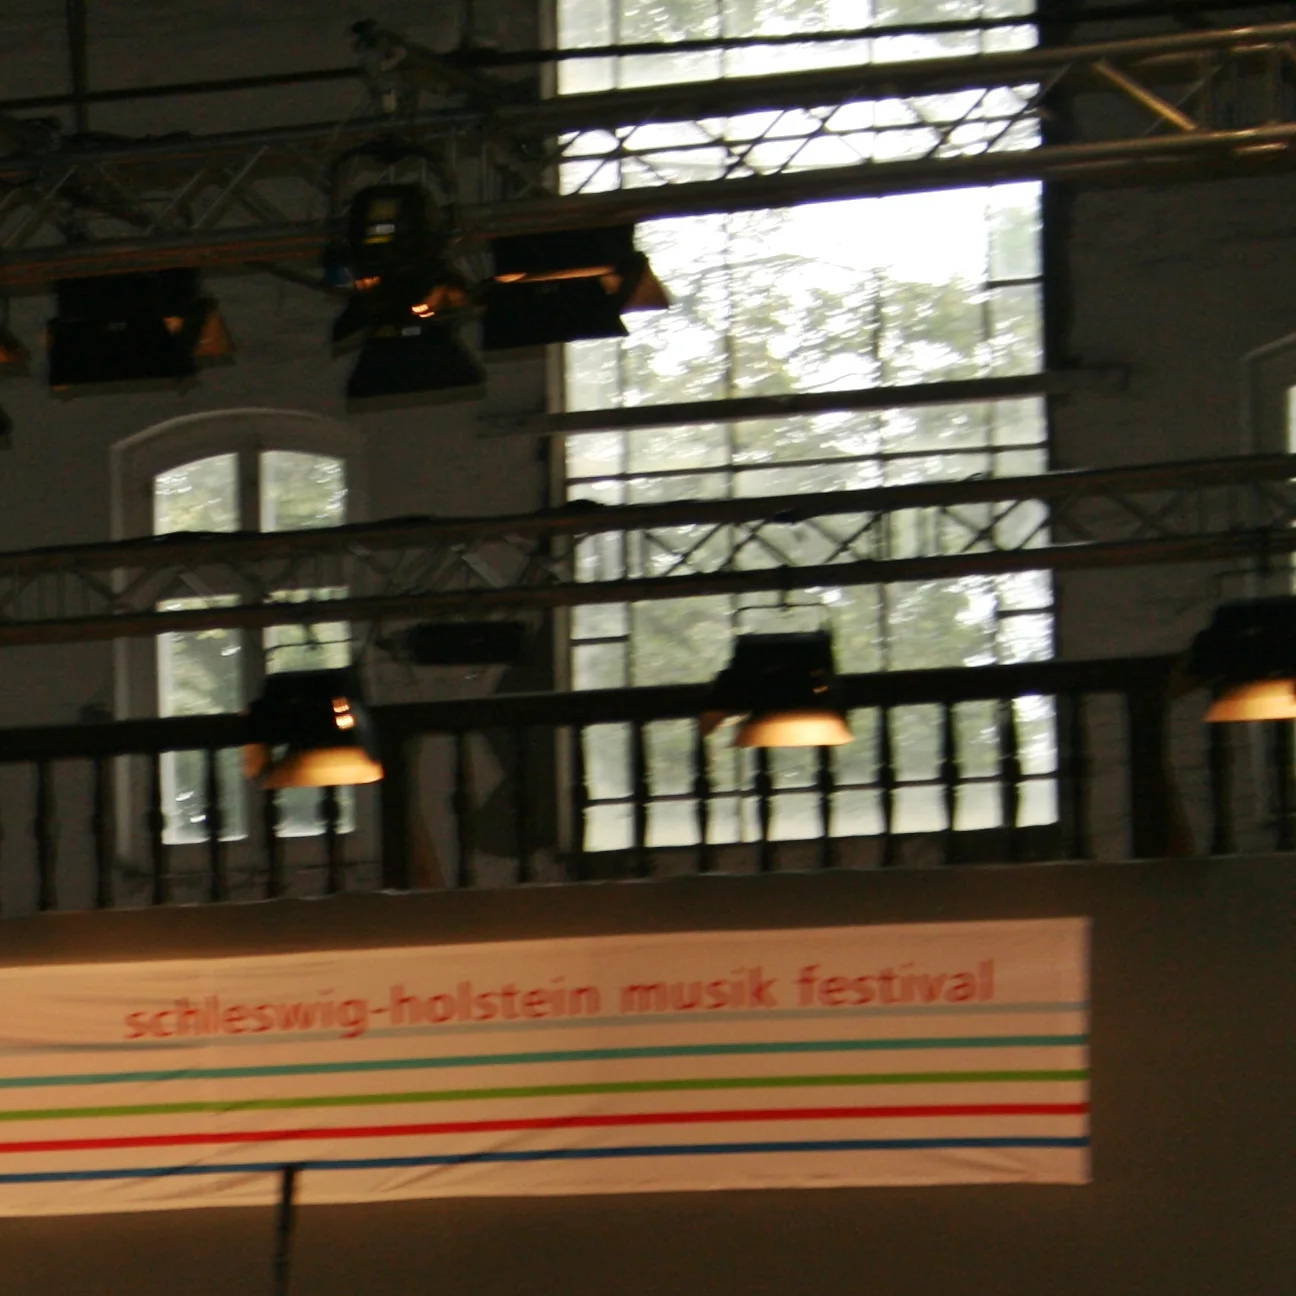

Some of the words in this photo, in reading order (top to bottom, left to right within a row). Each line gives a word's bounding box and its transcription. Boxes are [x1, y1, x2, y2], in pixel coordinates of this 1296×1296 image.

[125, 977, 600, 1038] schleswig-holstein
[621, 967, 776, 1011] musik
[796, 960, 996, 1006] festival
